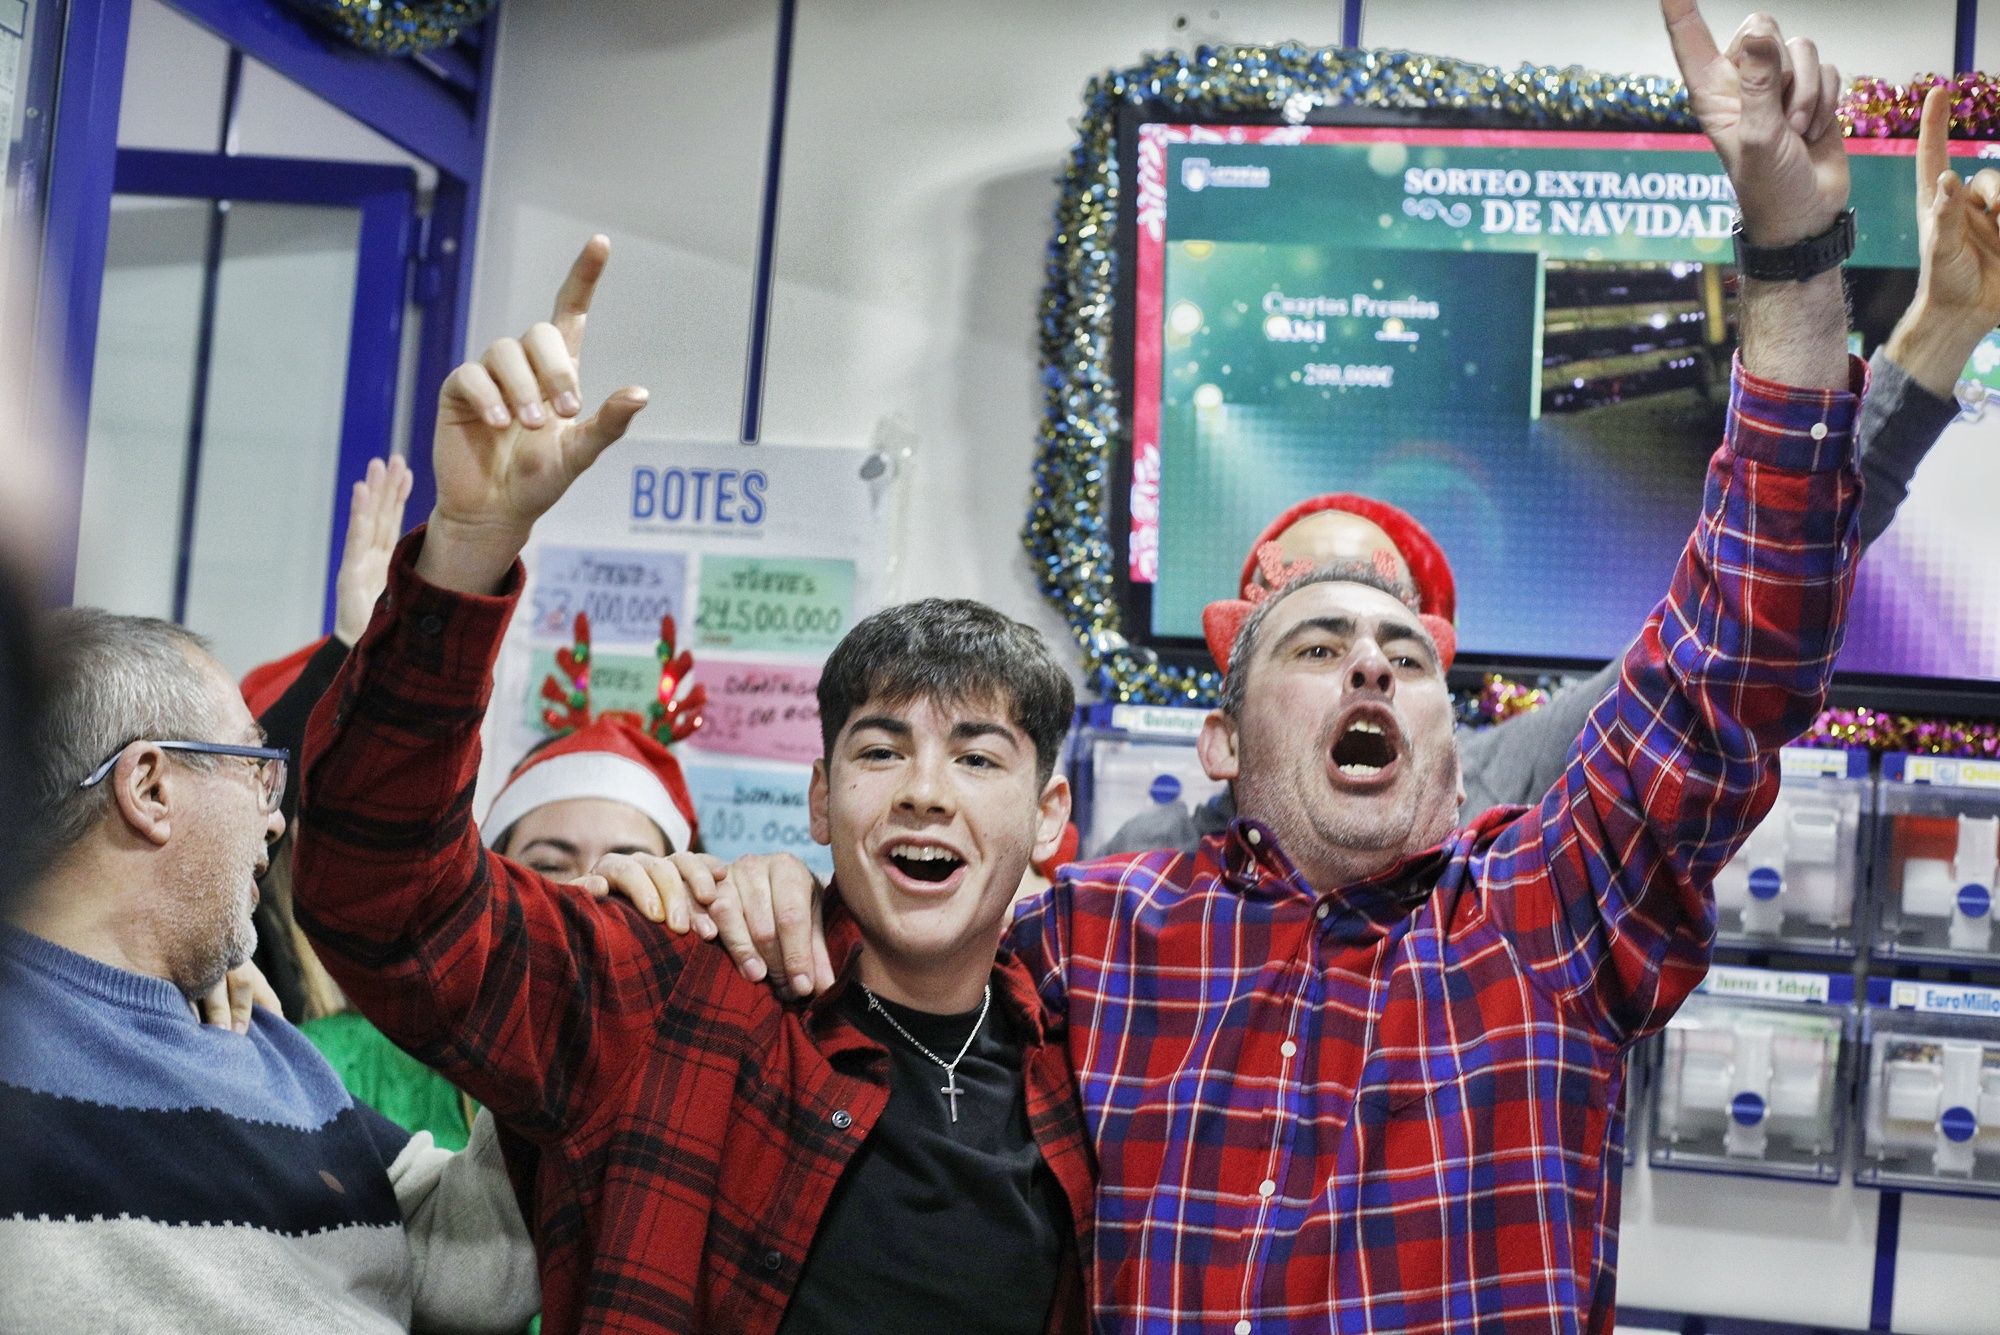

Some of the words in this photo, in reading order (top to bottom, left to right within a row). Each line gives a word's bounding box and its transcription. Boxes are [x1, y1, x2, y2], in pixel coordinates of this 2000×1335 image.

[1404, 168, 1531, 197] SORTEO
[1483, 201, 1541, 233] DE
[1551, 202, 1737, 238] NAVIDAD
[1263, 292, 1348, 316] Cuartos
[1353, 294, 1438, 319] Premios
[632, 468, 767, 524] BOTES
